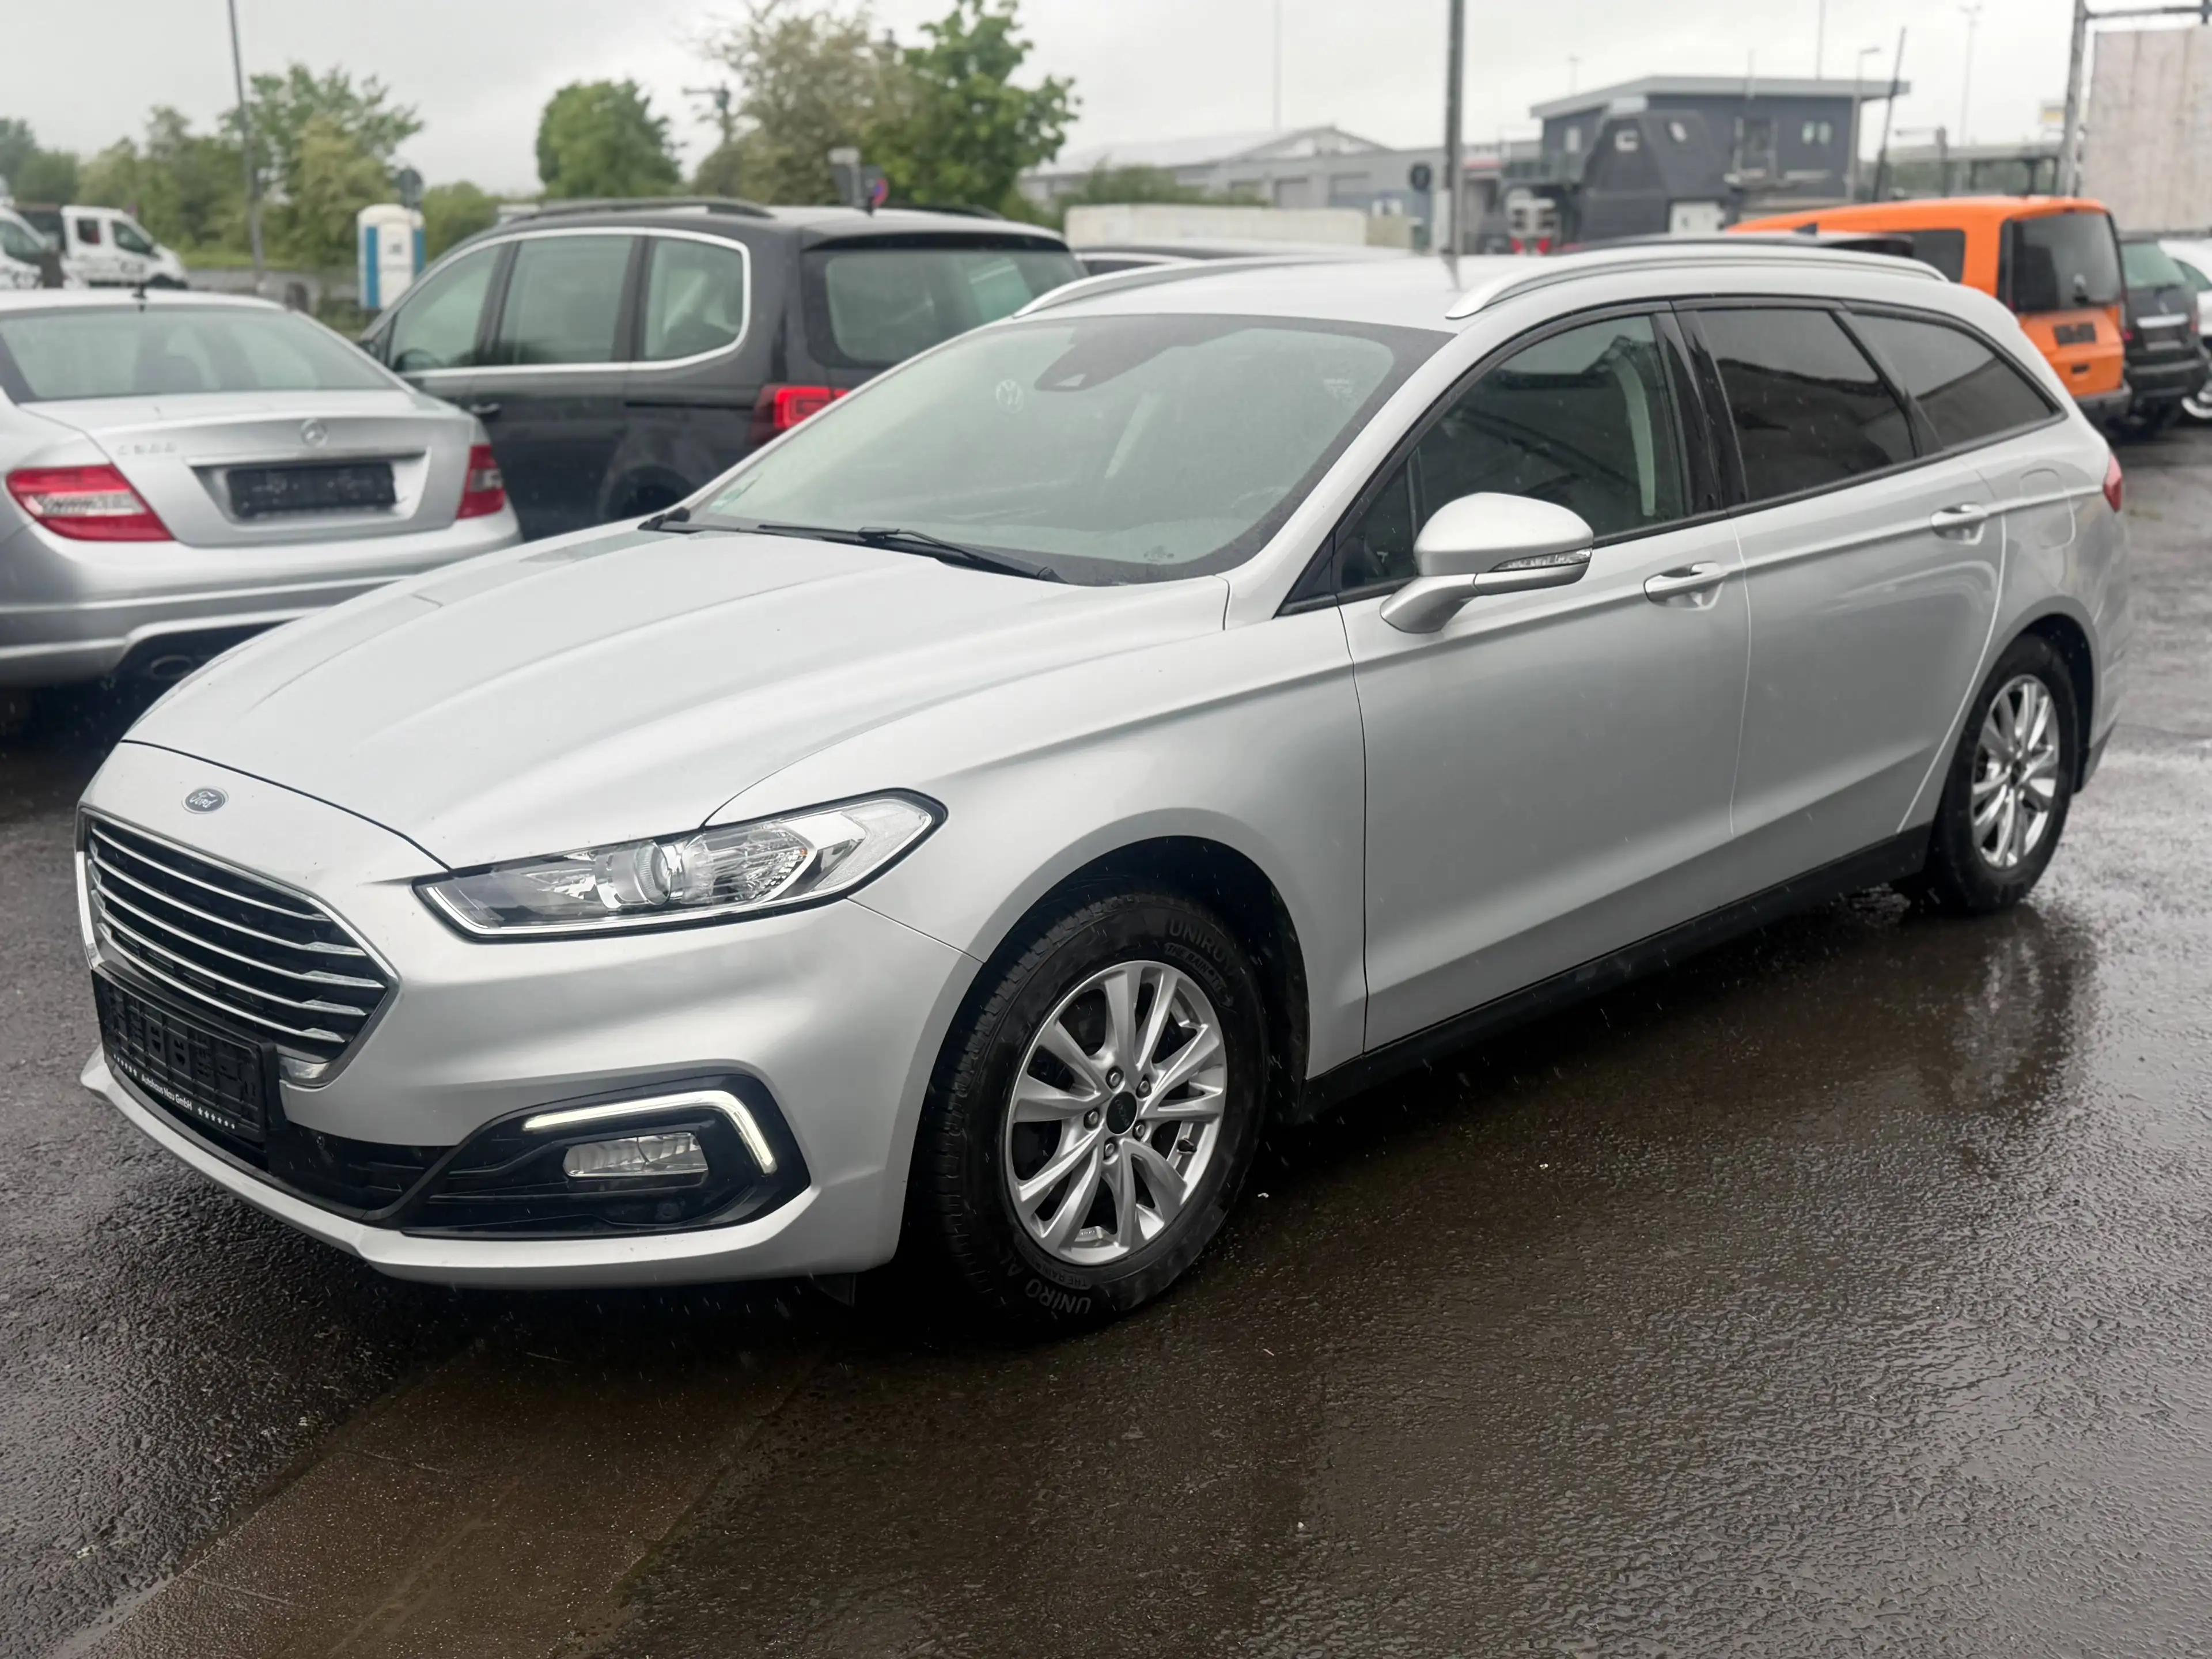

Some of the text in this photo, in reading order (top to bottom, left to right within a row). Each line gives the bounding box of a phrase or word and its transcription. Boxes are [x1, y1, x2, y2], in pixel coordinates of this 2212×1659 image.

[188, 790, 219, 809] Ford
[1187, 953, 1209, 972] RAIN
[141, 1074, 192, 1111] Autohaus Nau GmbH
[1067, 1278, 1086, 1288] THE
